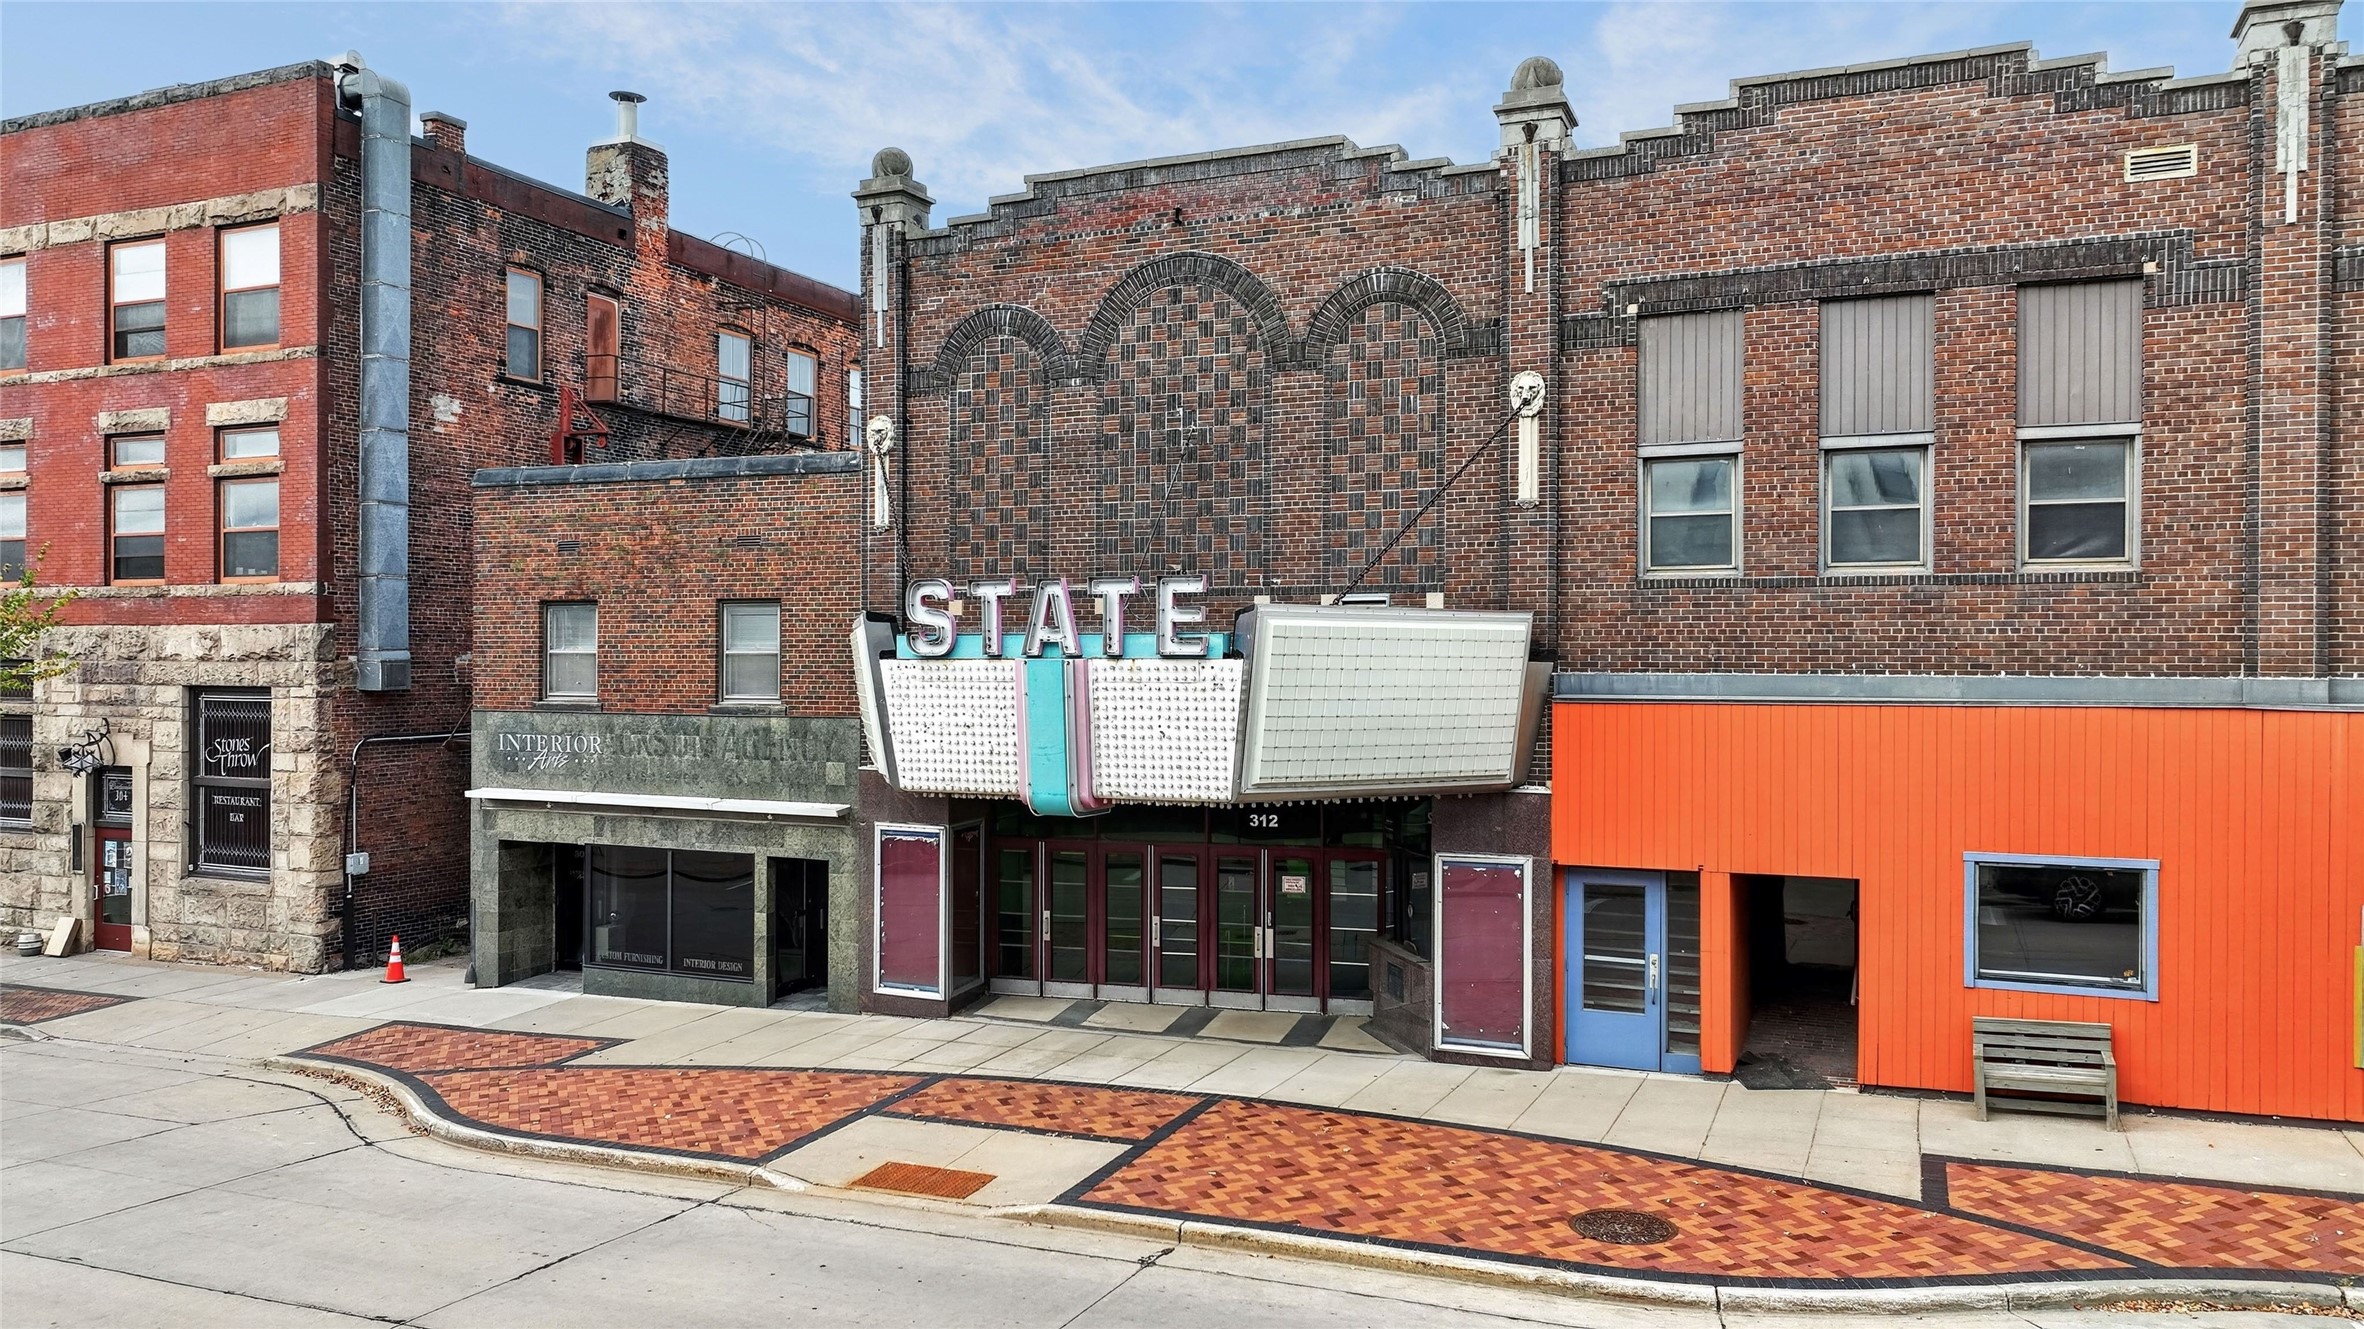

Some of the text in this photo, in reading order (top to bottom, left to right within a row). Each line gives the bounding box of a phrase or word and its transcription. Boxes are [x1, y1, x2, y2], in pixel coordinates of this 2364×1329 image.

[905, 574, 1209, 657] STATE
[499, 733, 602, 754] INTERIOR
[213, 743, 270, 775] Throw
[528, 748, 571, 771] Arts
[212, 795, 261, 806] RESTAURANT
[229, 812, 244, 822] BAR
[1249, 814, 1279, 827] 312
[624, 952, 663, 964] FURNISHING
[683, 957, 743, 972] INTERIOR DESIGN
